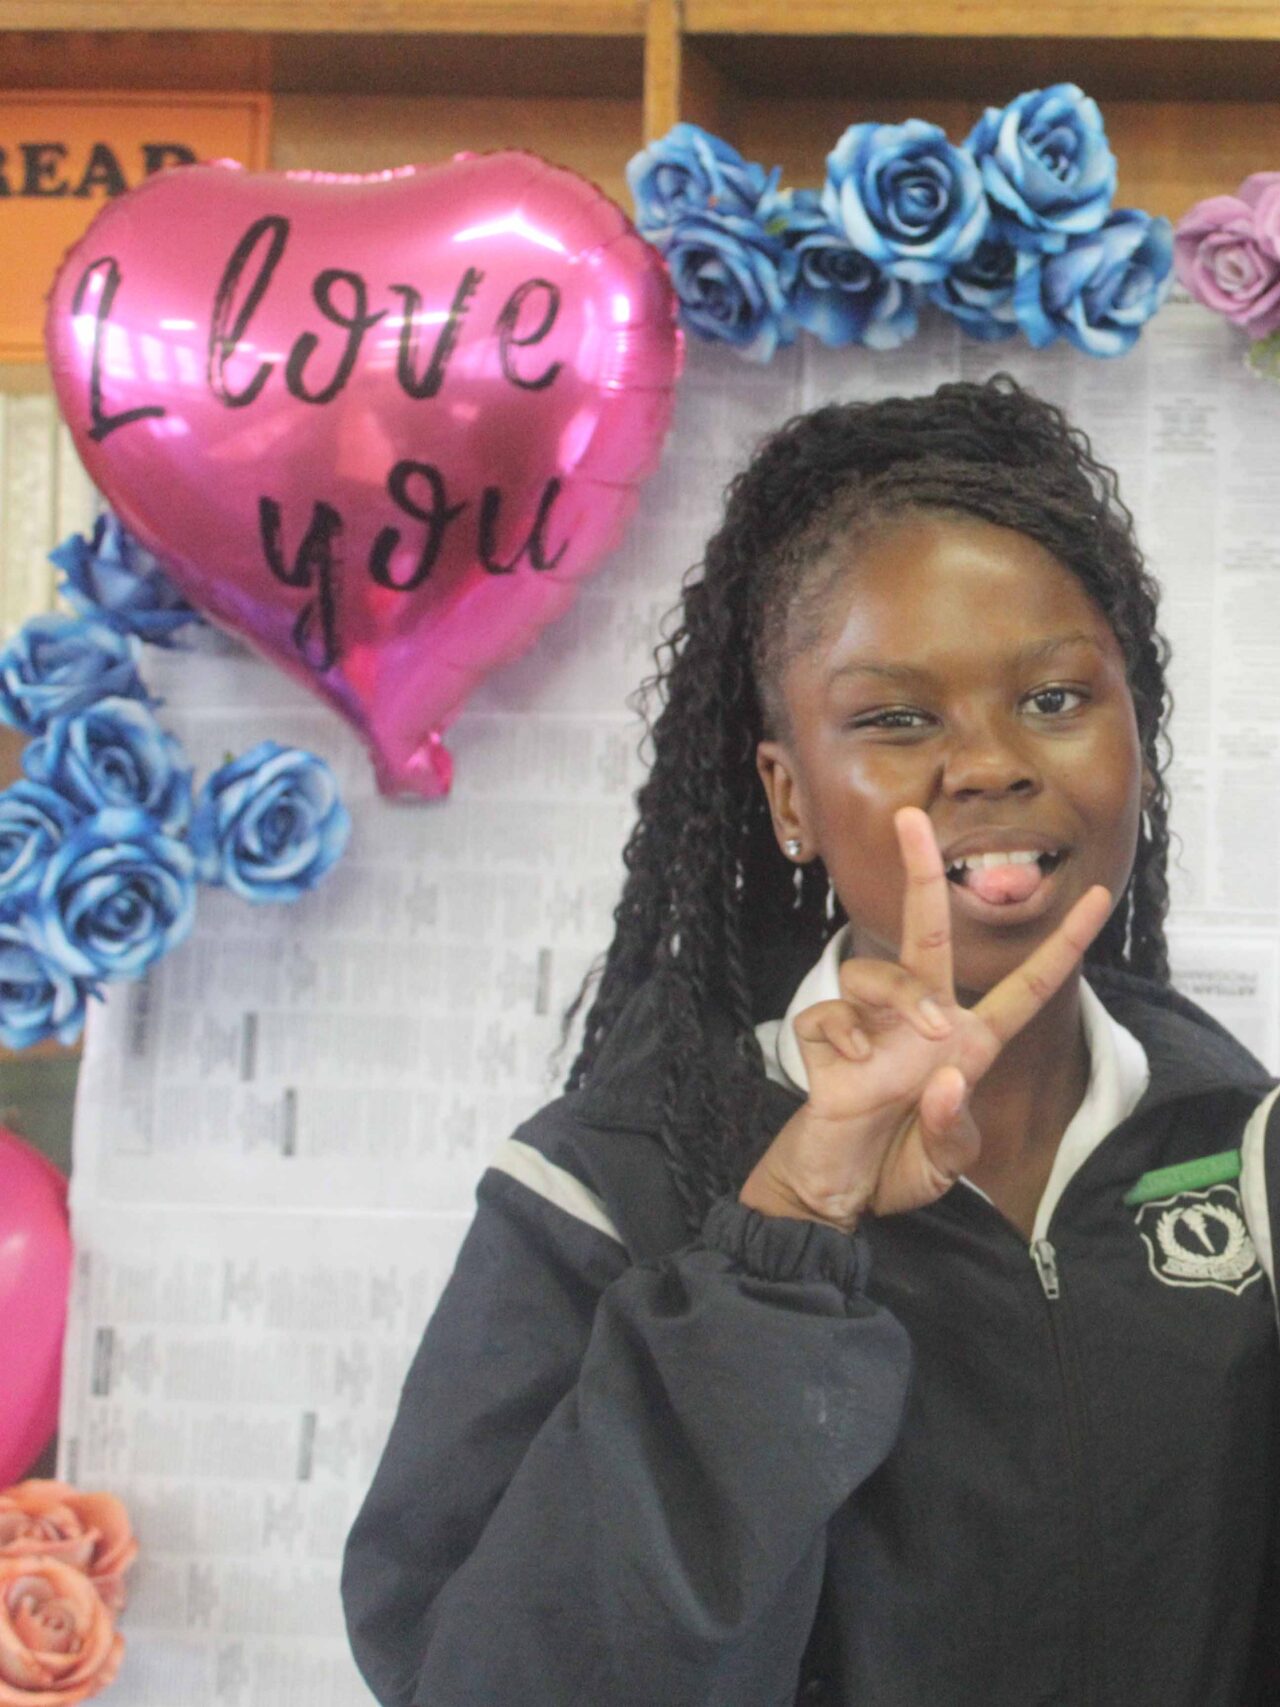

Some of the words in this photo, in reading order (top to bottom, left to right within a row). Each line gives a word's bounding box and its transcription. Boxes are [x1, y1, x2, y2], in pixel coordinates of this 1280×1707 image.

[0, 143, 199, 197] EA
[206, 214, 564, 408] love
[257, 459, 572, 672] you
